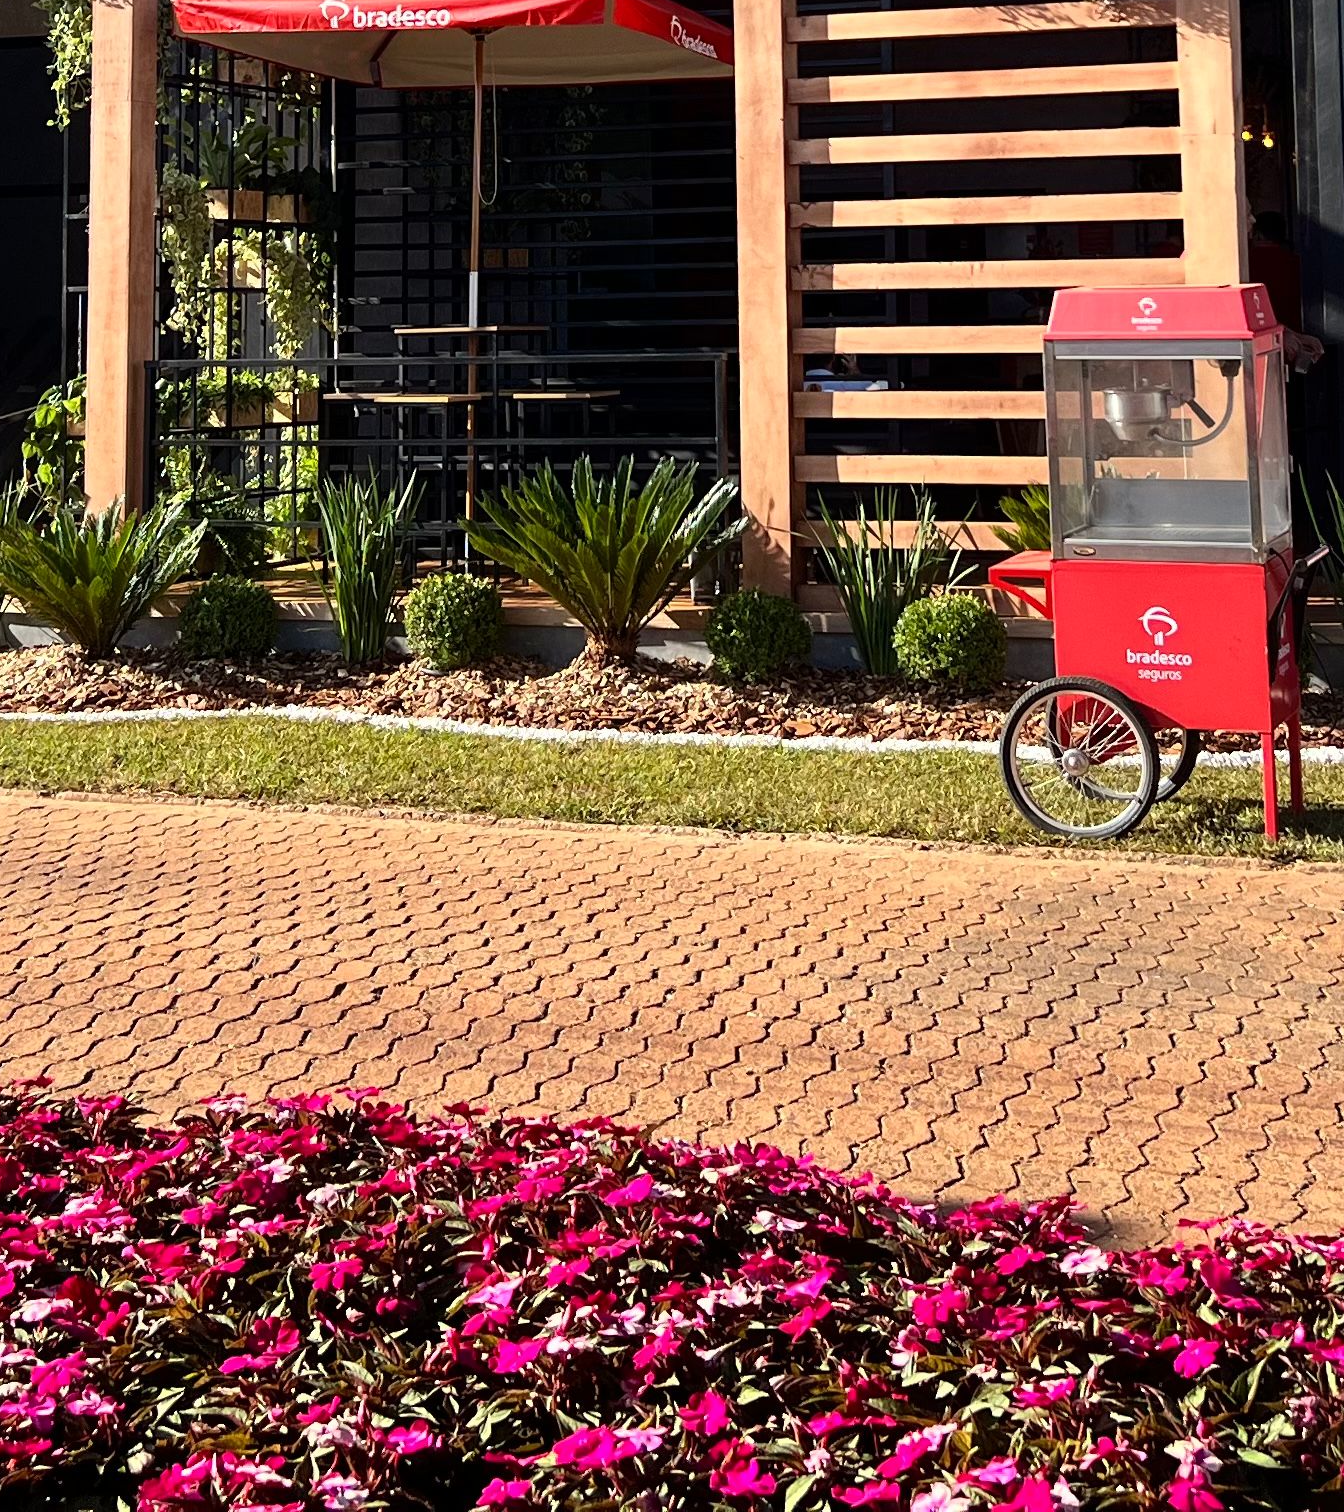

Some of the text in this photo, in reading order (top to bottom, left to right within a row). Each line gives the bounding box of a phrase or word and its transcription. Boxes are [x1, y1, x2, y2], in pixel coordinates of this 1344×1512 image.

[353, 4, 451, 29] bradesco
[1126, 648, 1193, 666] bradesco
[1138, 668, 1182, 683] seguros
